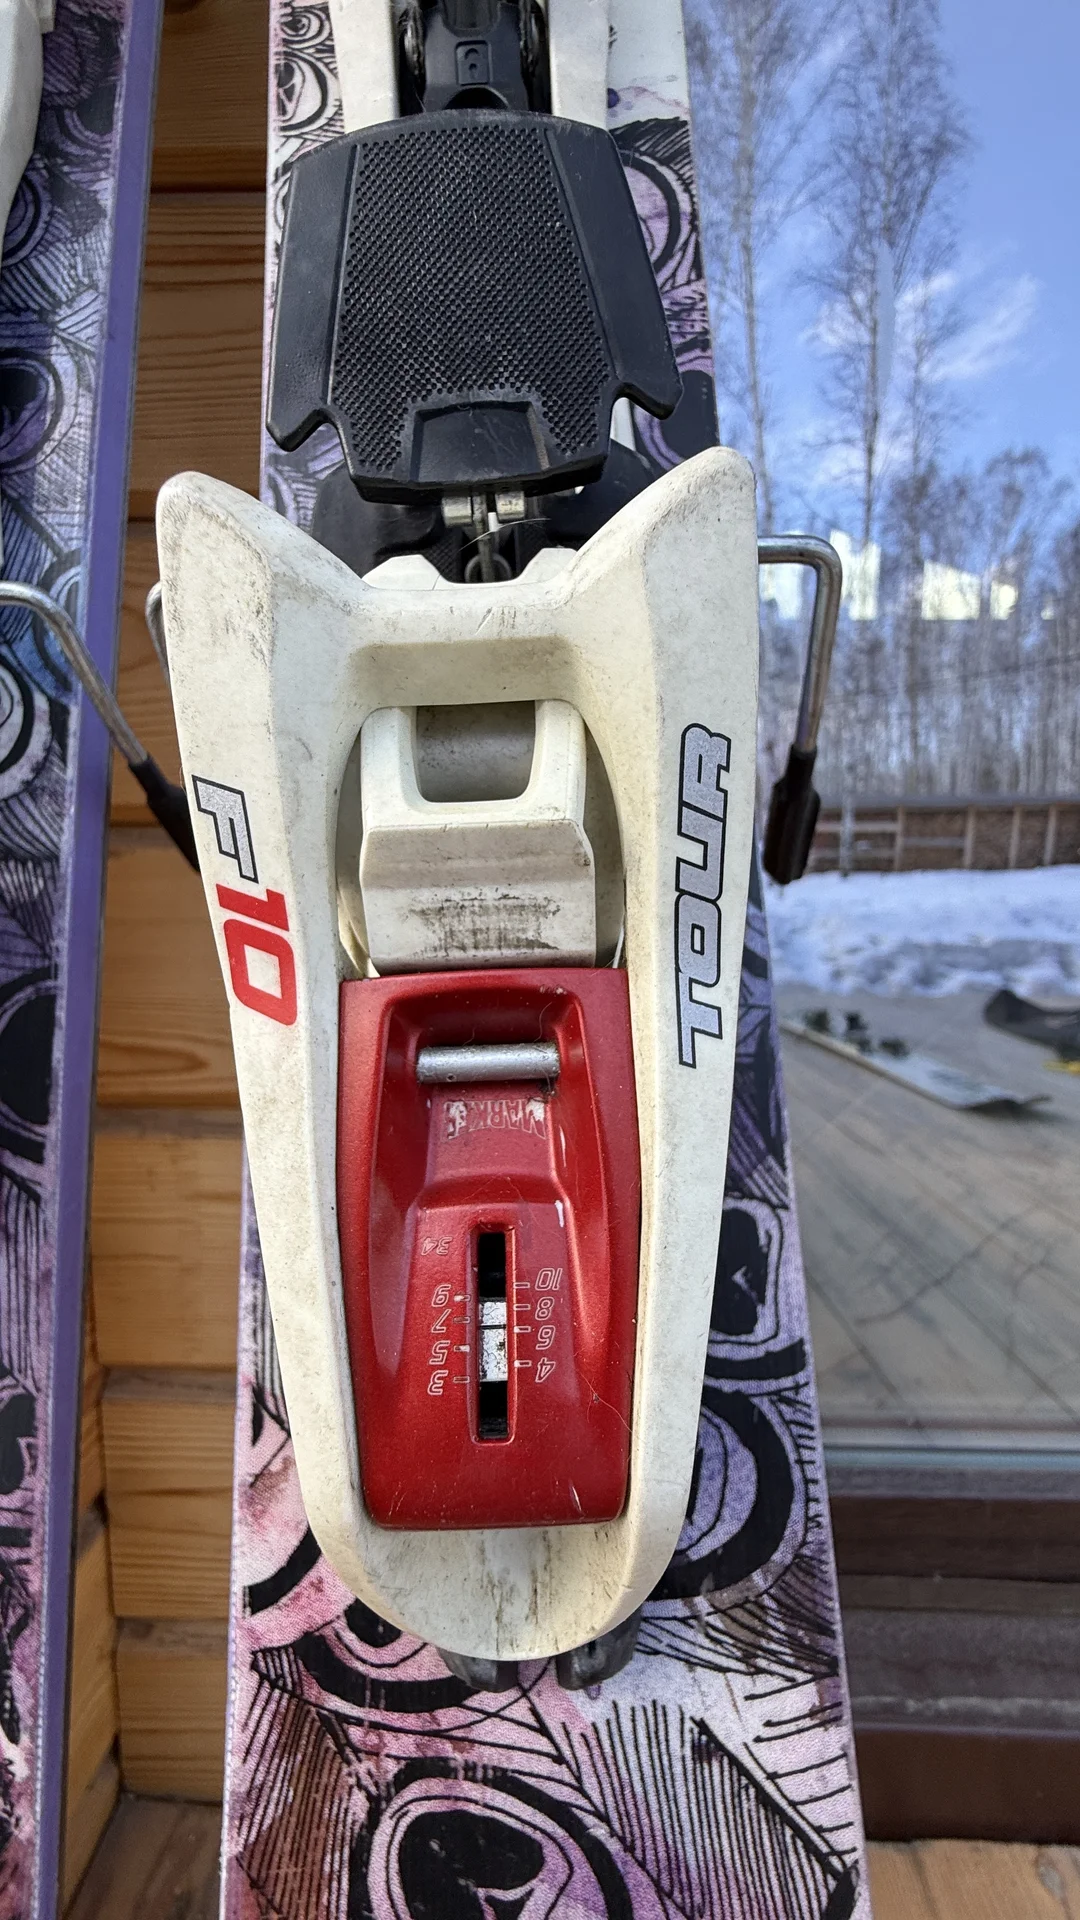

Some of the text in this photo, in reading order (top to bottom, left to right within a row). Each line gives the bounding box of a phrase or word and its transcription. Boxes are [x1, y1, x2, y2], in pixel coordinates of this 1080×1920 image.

[191, 774, 298, 1026] F10
[674, 722, 732, 1069] TOUR
[443, 1097, 547, 1140] MARK
[420, 1236, 453, 1256] 34
[534, 1267, 563, 1291] 10
[431, 1284, 452, 1308] 9
[534, 1296, 556, 1321] 8
[431, 1308, 452, 1333] 7
[535, 1325, 556, 1351] 6
[428, 1340, 451, 1365] 5
[426, 1369, 449, 1396] 3
[534, 1357, 557, 1383] 4
